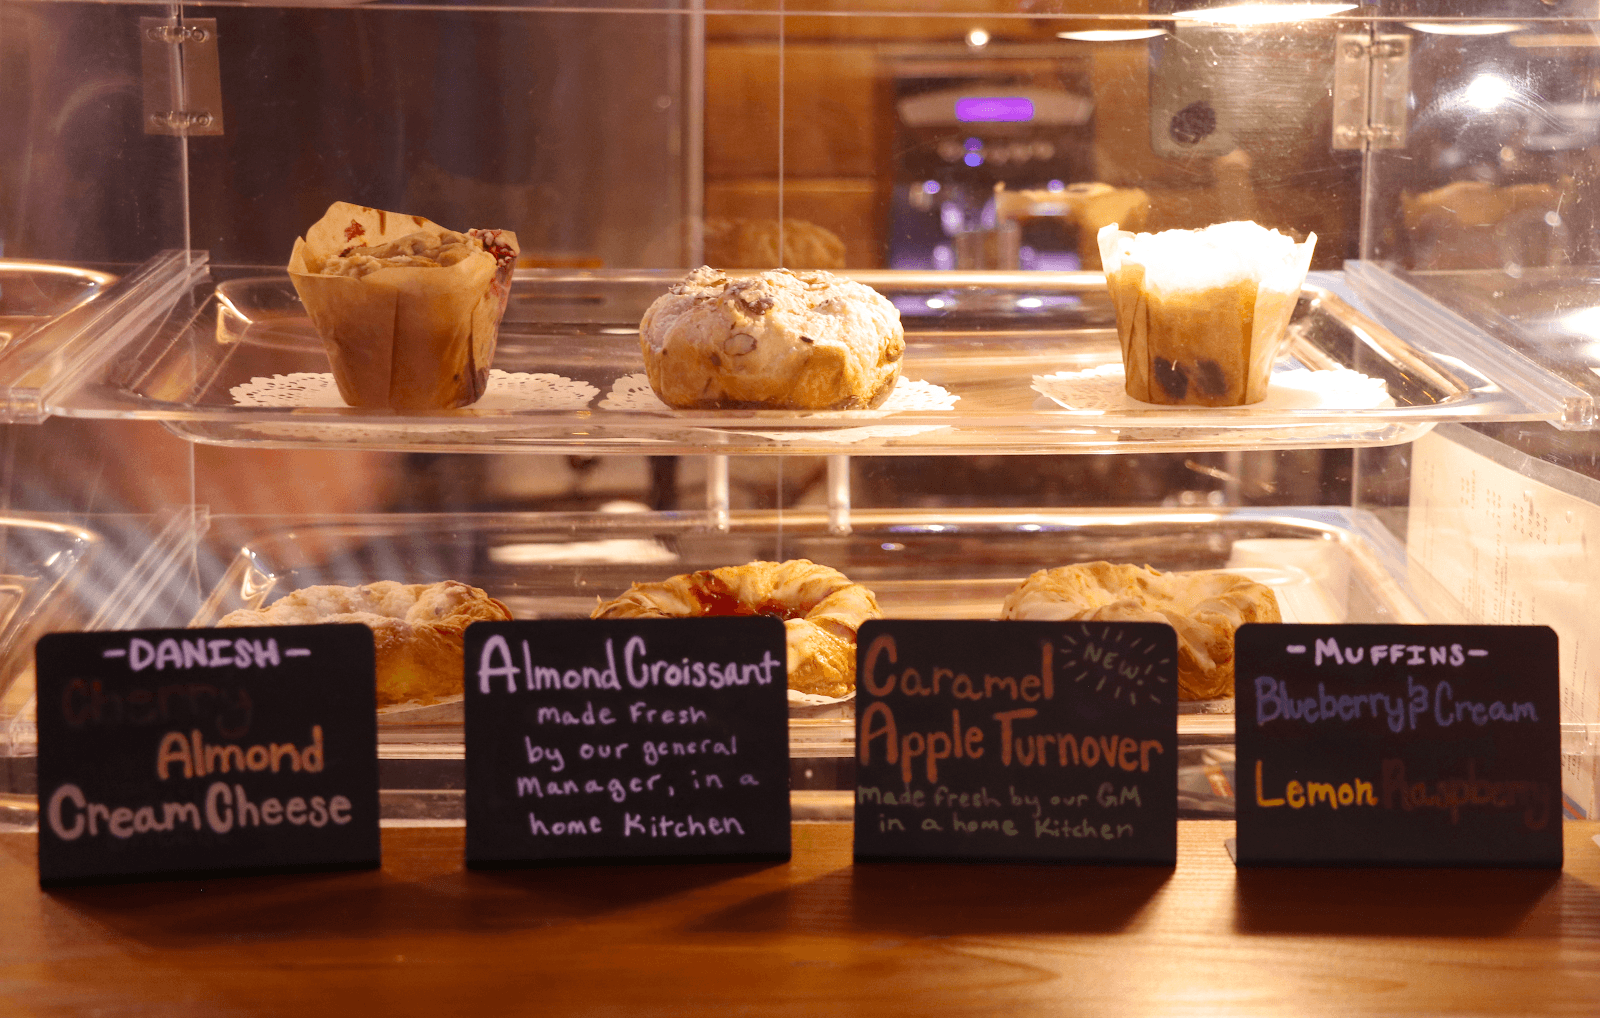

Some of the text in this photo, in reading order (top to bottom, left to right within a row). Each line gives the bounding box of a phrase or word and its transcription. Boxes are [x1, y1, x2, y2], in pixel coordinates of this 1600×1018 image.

[477, 634, 781, 693] Almond Croissant
[862, 632, 1055, 702] Caramel
[1254, 675, 1405, 733] Blueberry
[1434, 680, 1539, 727] Cream
[156, 725, 324, 781] Almond
[524, 736, 737, 772] by our general
[859, 700, 1165, 784] Apple Turnover
[691, 769, 723, 789] in
[739, 773, 760, 786] a
[1009, 785, 1042, 819] by
[1050, 793, 1090, 807] our
[1096, 781, 1142, 808] GM
[1255, 759, 1379, 810] Lemon
[47, 781, 352, 841] Cream Cheese
[529, 812, 602, 836] home
[878, 813, 907, 833] in
[921, 817, 944, 832] a
[952, 811, 1020, 837] home
